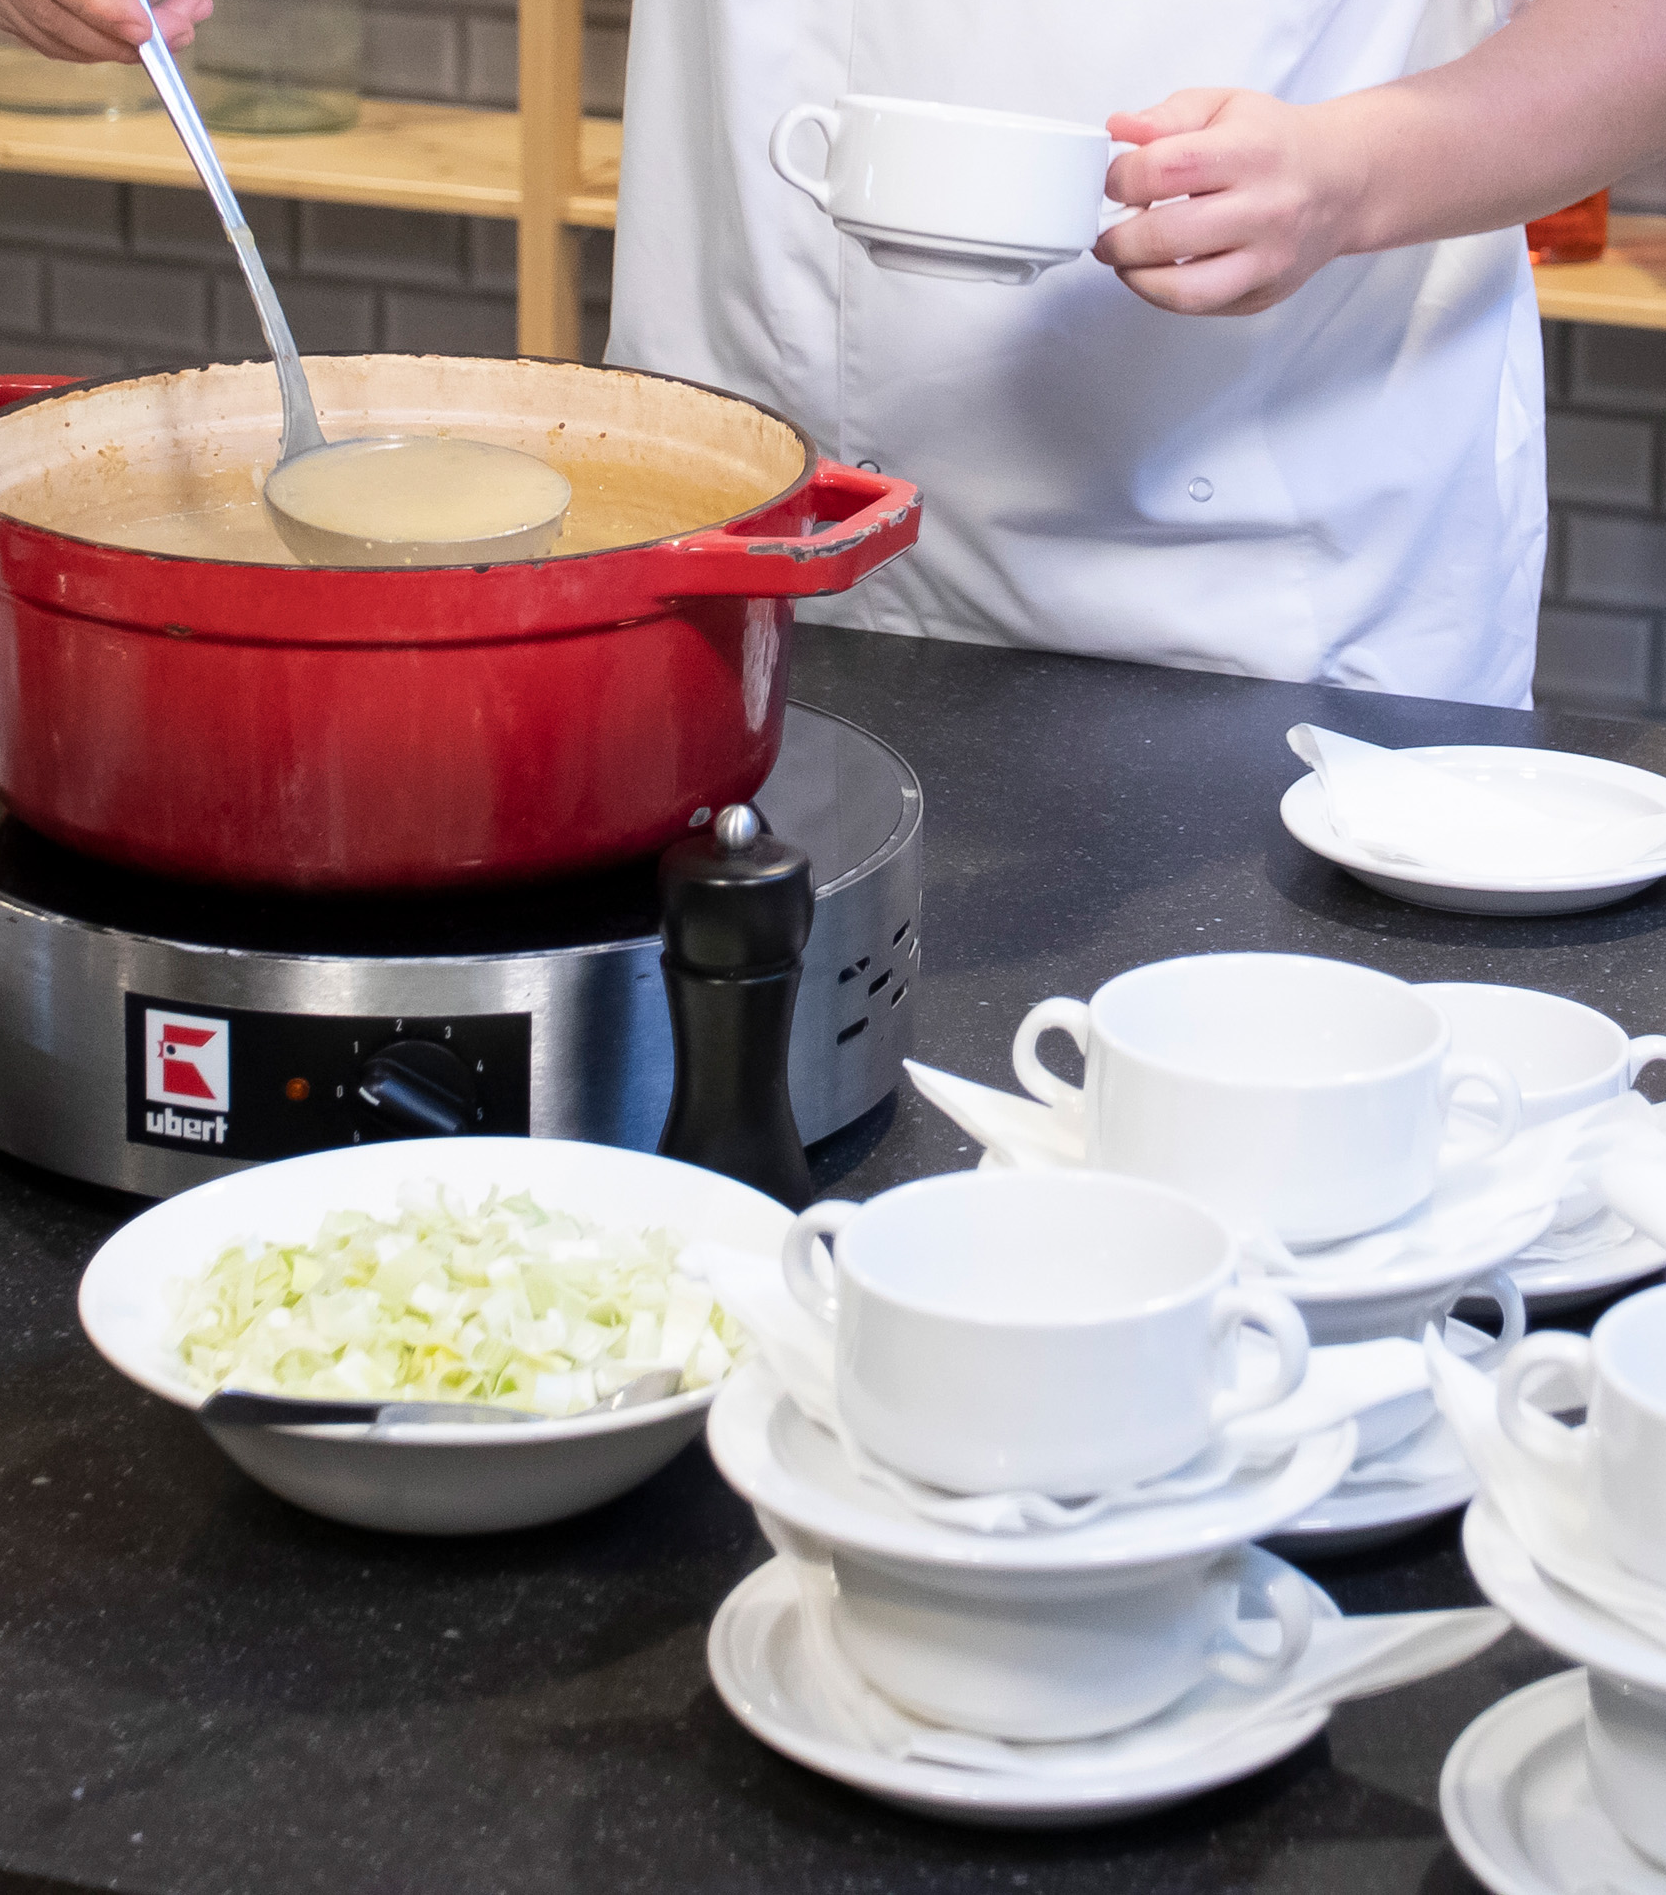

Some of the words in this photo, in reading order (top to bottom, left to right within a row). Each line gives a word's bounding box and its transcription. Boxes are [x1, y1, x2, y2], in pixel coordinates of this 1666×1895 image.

[395, 1018, 403, 1032] 2
[444, 1025, 452, 1039] 3
[476, 1059, 484, 1072] 4
[336, 1085, 344, 1098] 0
[476, 1107, 483, 1121] 5
[145, 1107, 229, 1144] ubert
